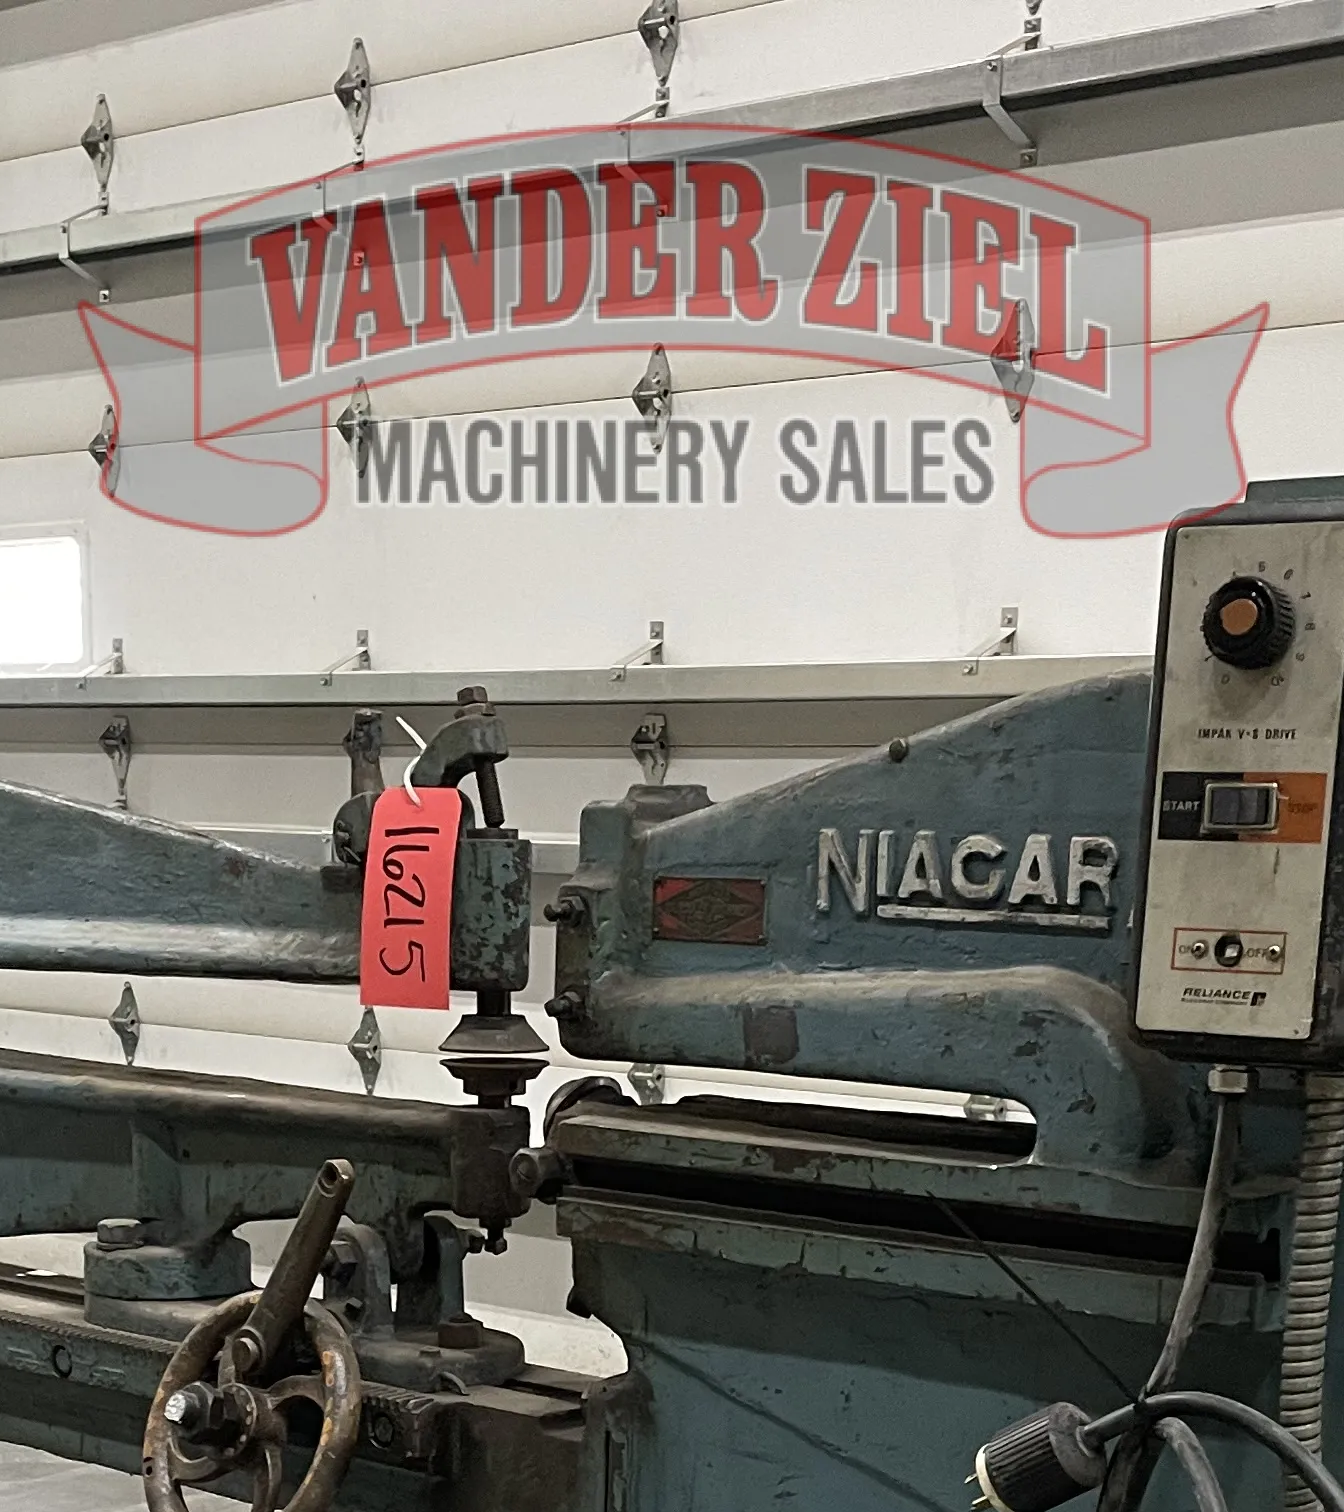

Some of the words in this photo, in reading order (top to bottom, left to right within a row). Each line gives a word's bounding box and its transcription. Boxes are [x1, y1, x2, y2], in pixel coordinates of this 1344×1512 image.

[1265, 728, 1296, 740] DRIVE
[1162, 800, 1201, 811] START
[817, 828, 1133, 926] NIAGAR
[378, 825, 440, 984] 16215
[1183, 987, 1251, 999] RELIANCE
